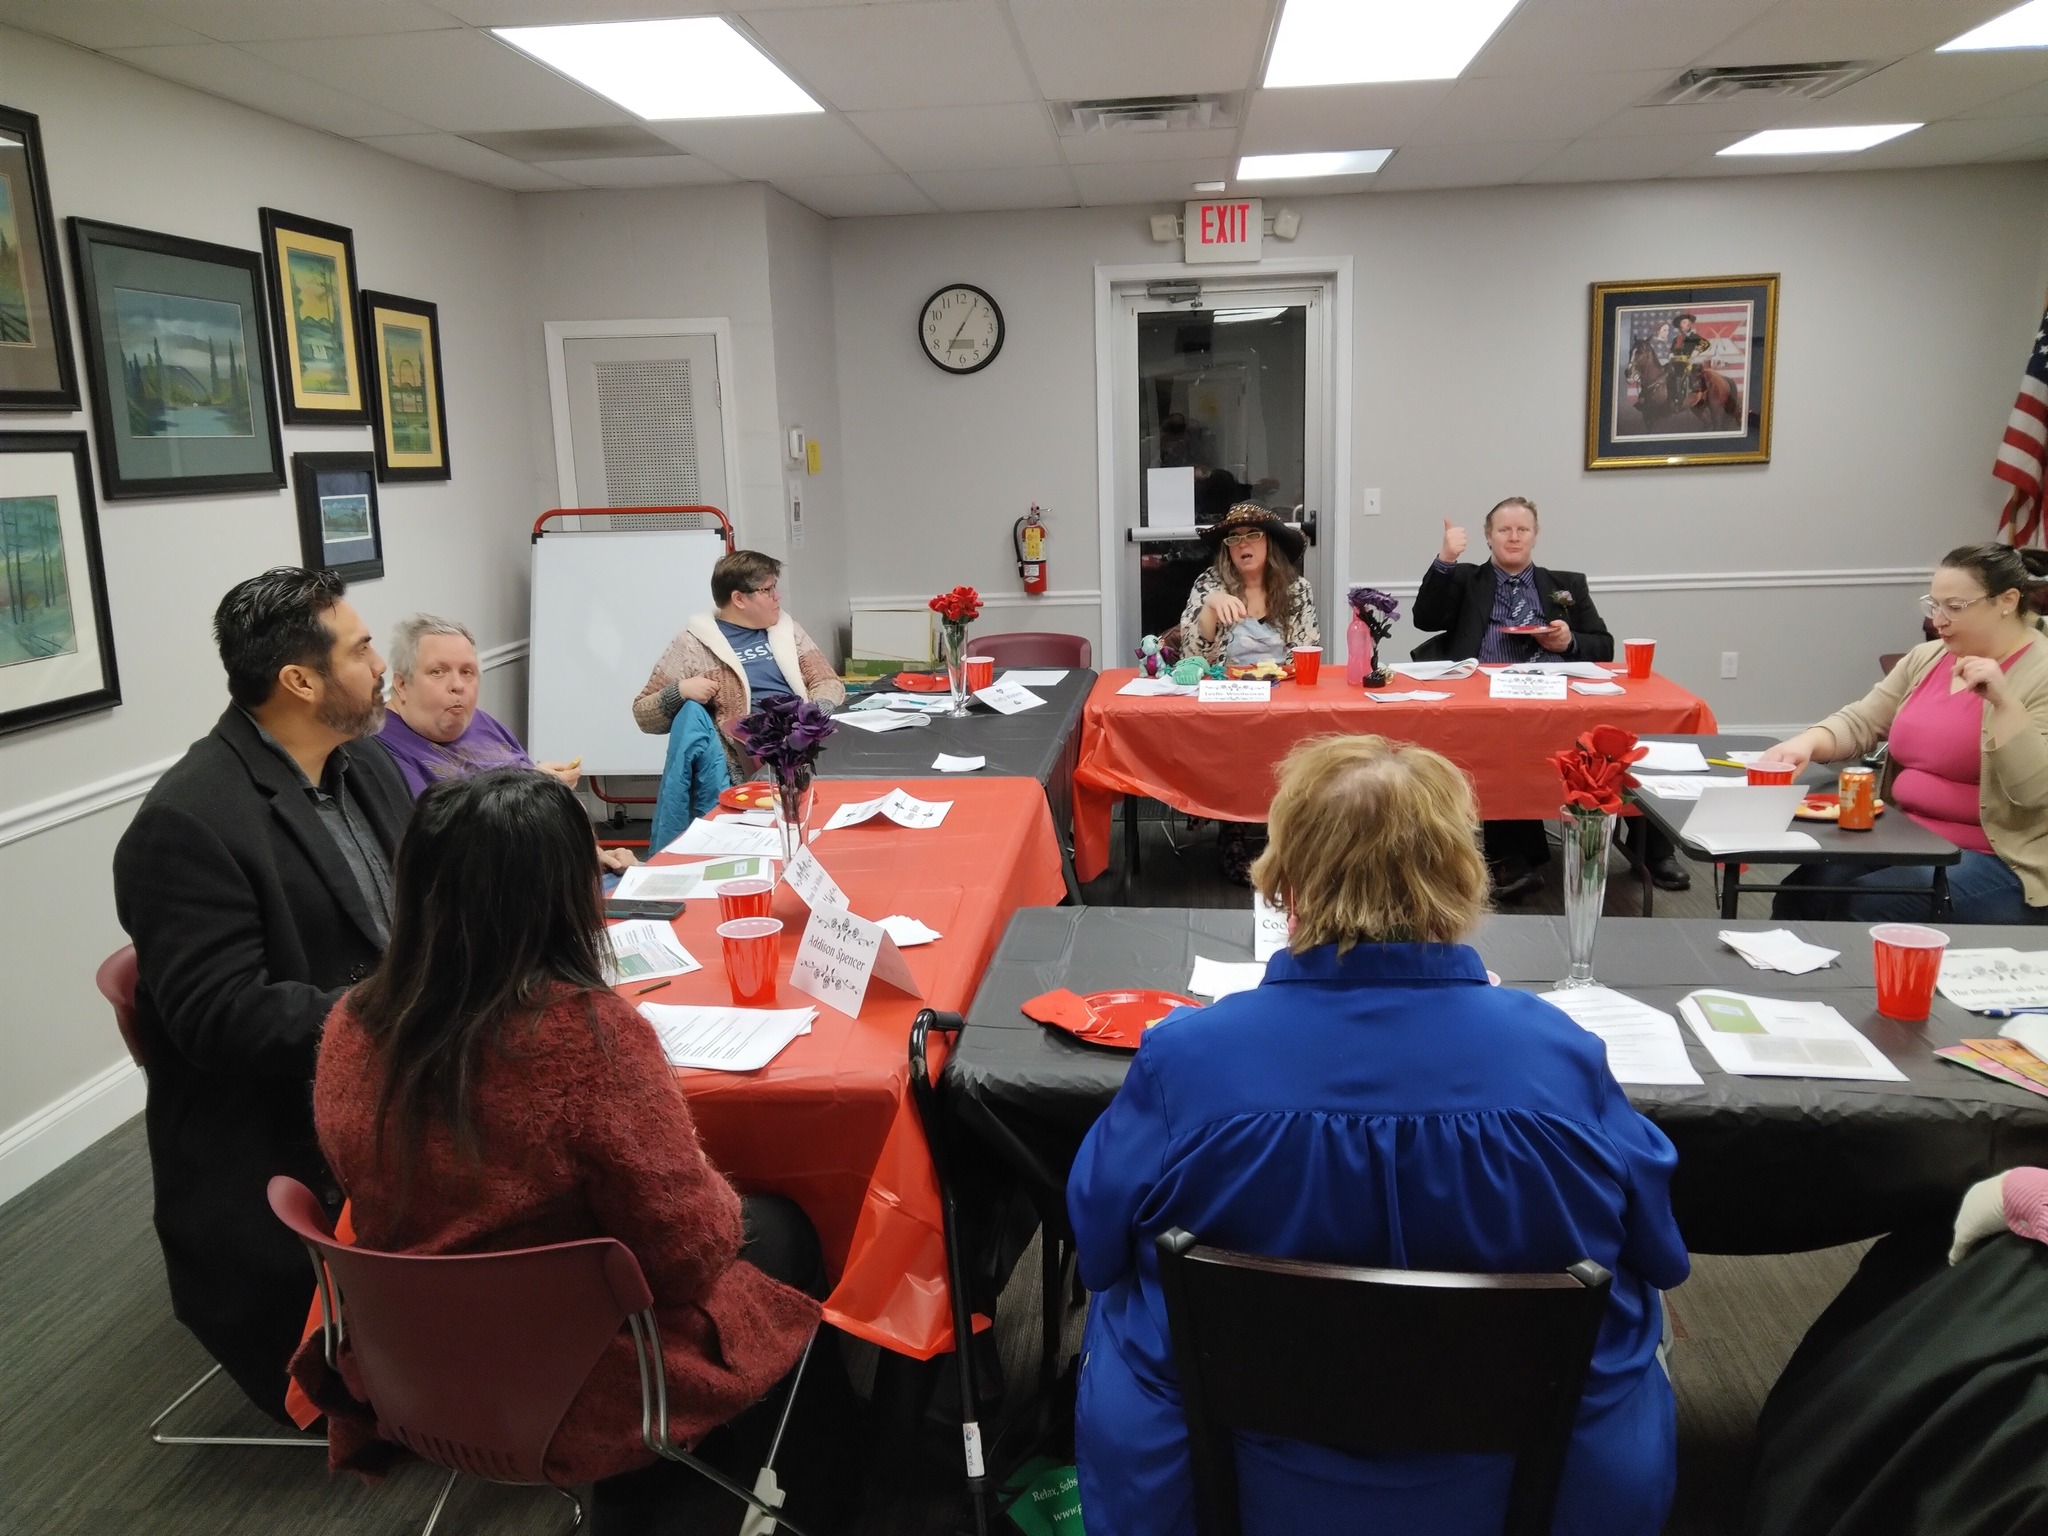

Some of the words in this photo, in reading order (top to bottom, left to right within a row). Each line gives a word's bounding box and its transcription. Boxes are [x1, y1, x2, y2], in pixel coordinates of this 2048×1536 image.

[1201, 204, 1250, 245] EXIT
[941, 295, 951, 309] 11
[956, 293, 967, 304] 12
[932, 310, 943, 321] 10
[983, 307, 990, 318] 2
[929, 324, 936, 335] 9
[987, 322, 994, 334] 3
[933, 339, 940, 350] 8
[982, 338, 989, 349] 4
[945, 350, 952, 361] 7
[959, 353, 967, 364] 6
[973, 349, 980, 361] 5
[808, 934, 836, 957] Addison
[836, 948, 866, 972] Spencer
[1951, 989, 1969, 997] The
[1032, 1487, 1059, 1501] Relax,
